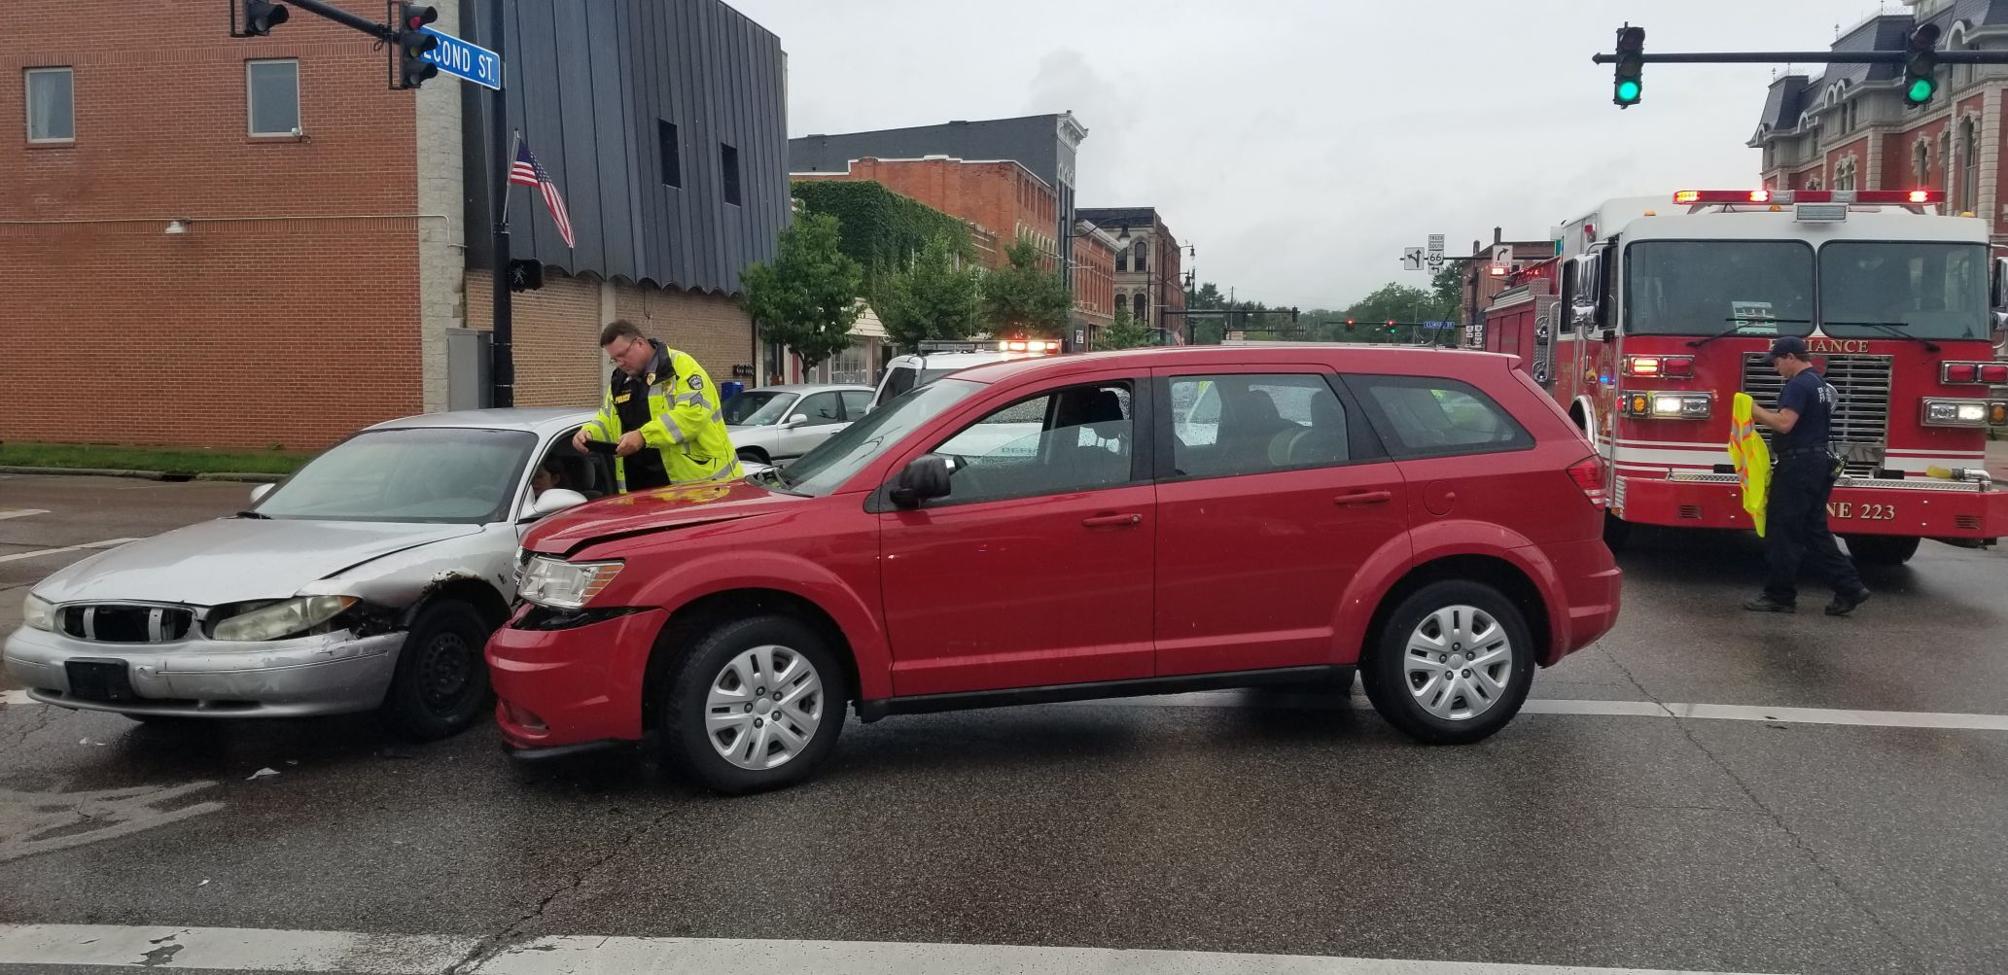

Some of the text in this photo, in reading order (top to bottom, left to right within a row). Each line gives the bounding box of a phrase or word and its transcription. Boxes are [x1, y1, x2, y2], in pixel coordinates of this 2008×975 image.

[423, 37, 470, 72] COND
[1429, 253, 1442, 262] 66
[1768, 339, 1869, 354] IANCE
[1860, 503, 1895, 520] 223
